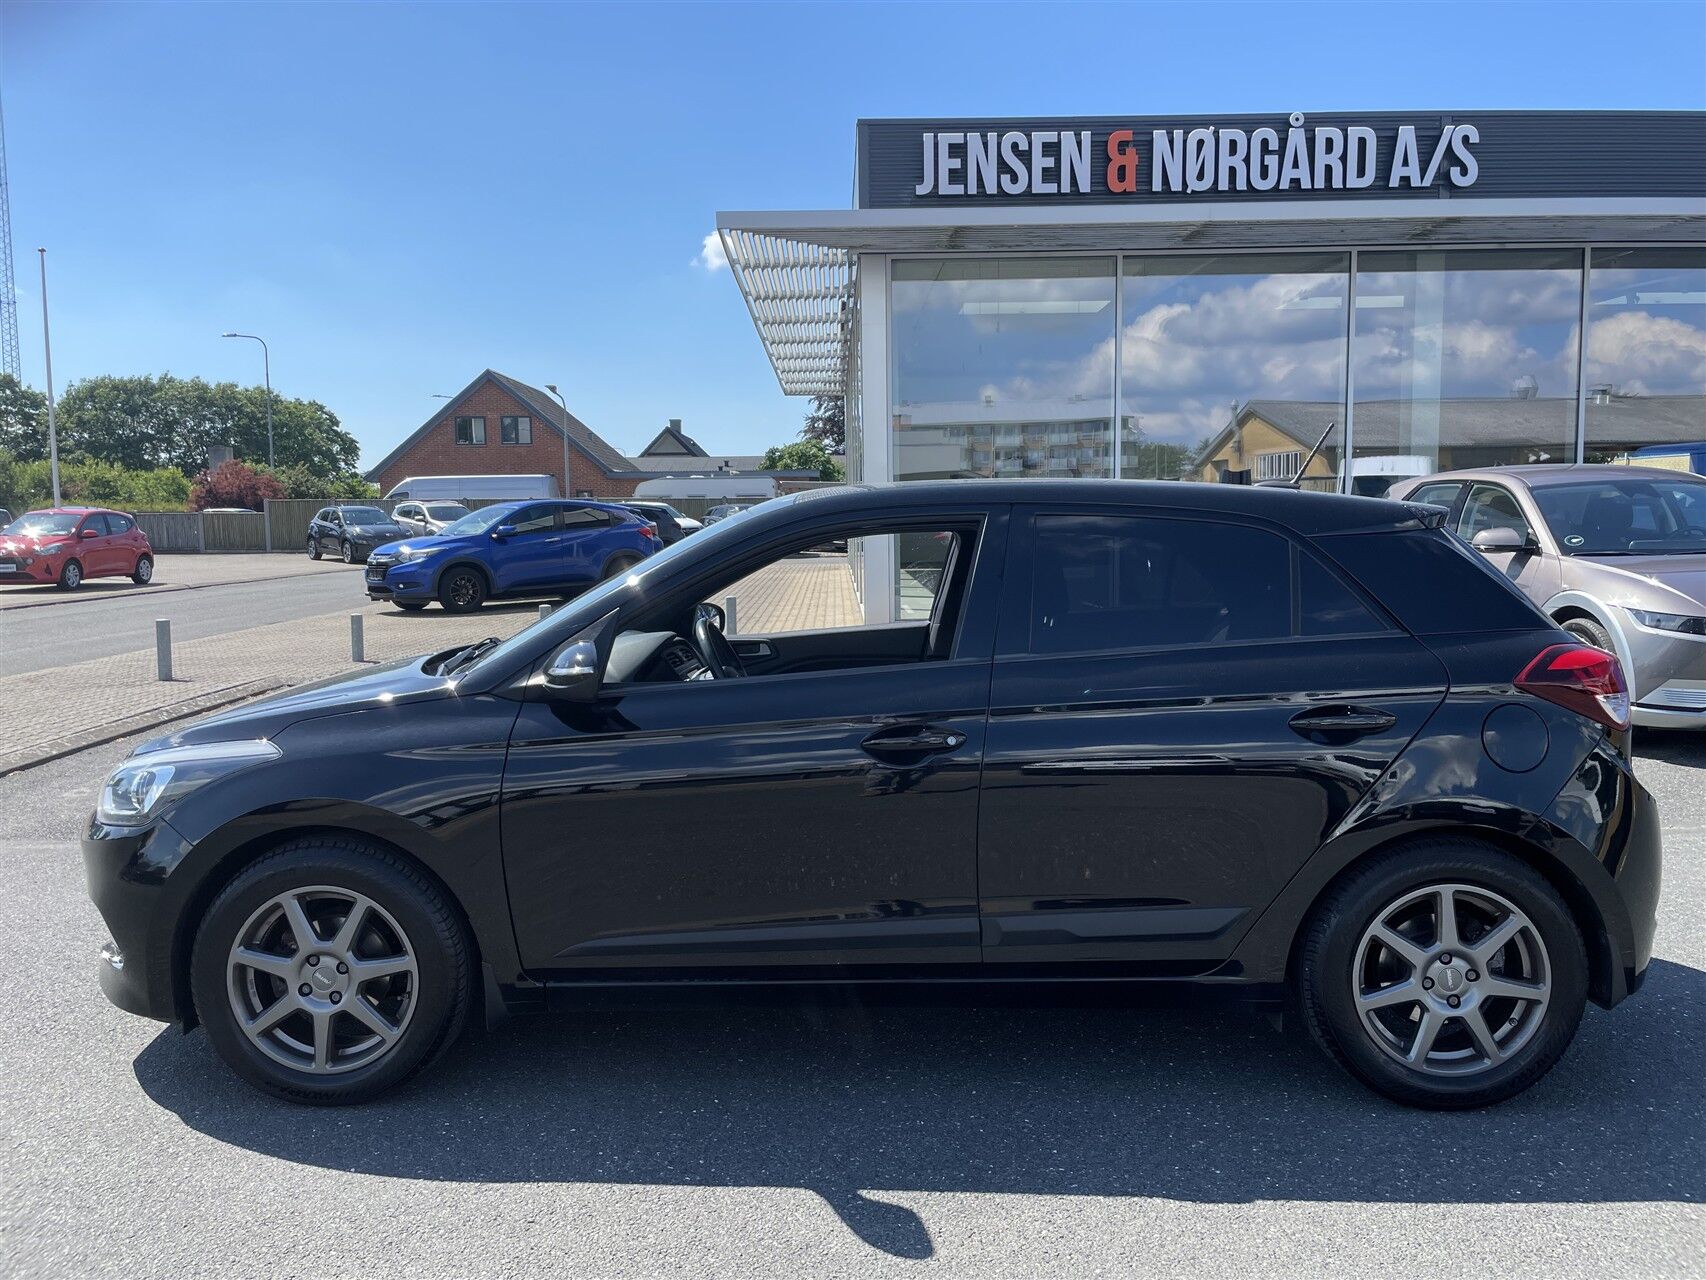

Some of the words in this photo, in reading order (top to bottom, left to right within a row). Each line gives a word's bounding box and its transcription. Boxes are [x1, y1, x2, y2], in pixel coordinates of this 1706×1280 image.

[915, 130, 1091, 195] JENSEN
[1106, 129, 1139, 193] &
[1151, 111, 1377, 195] NØRGÅRD
[1388, 124, 1480, 188] A/S
